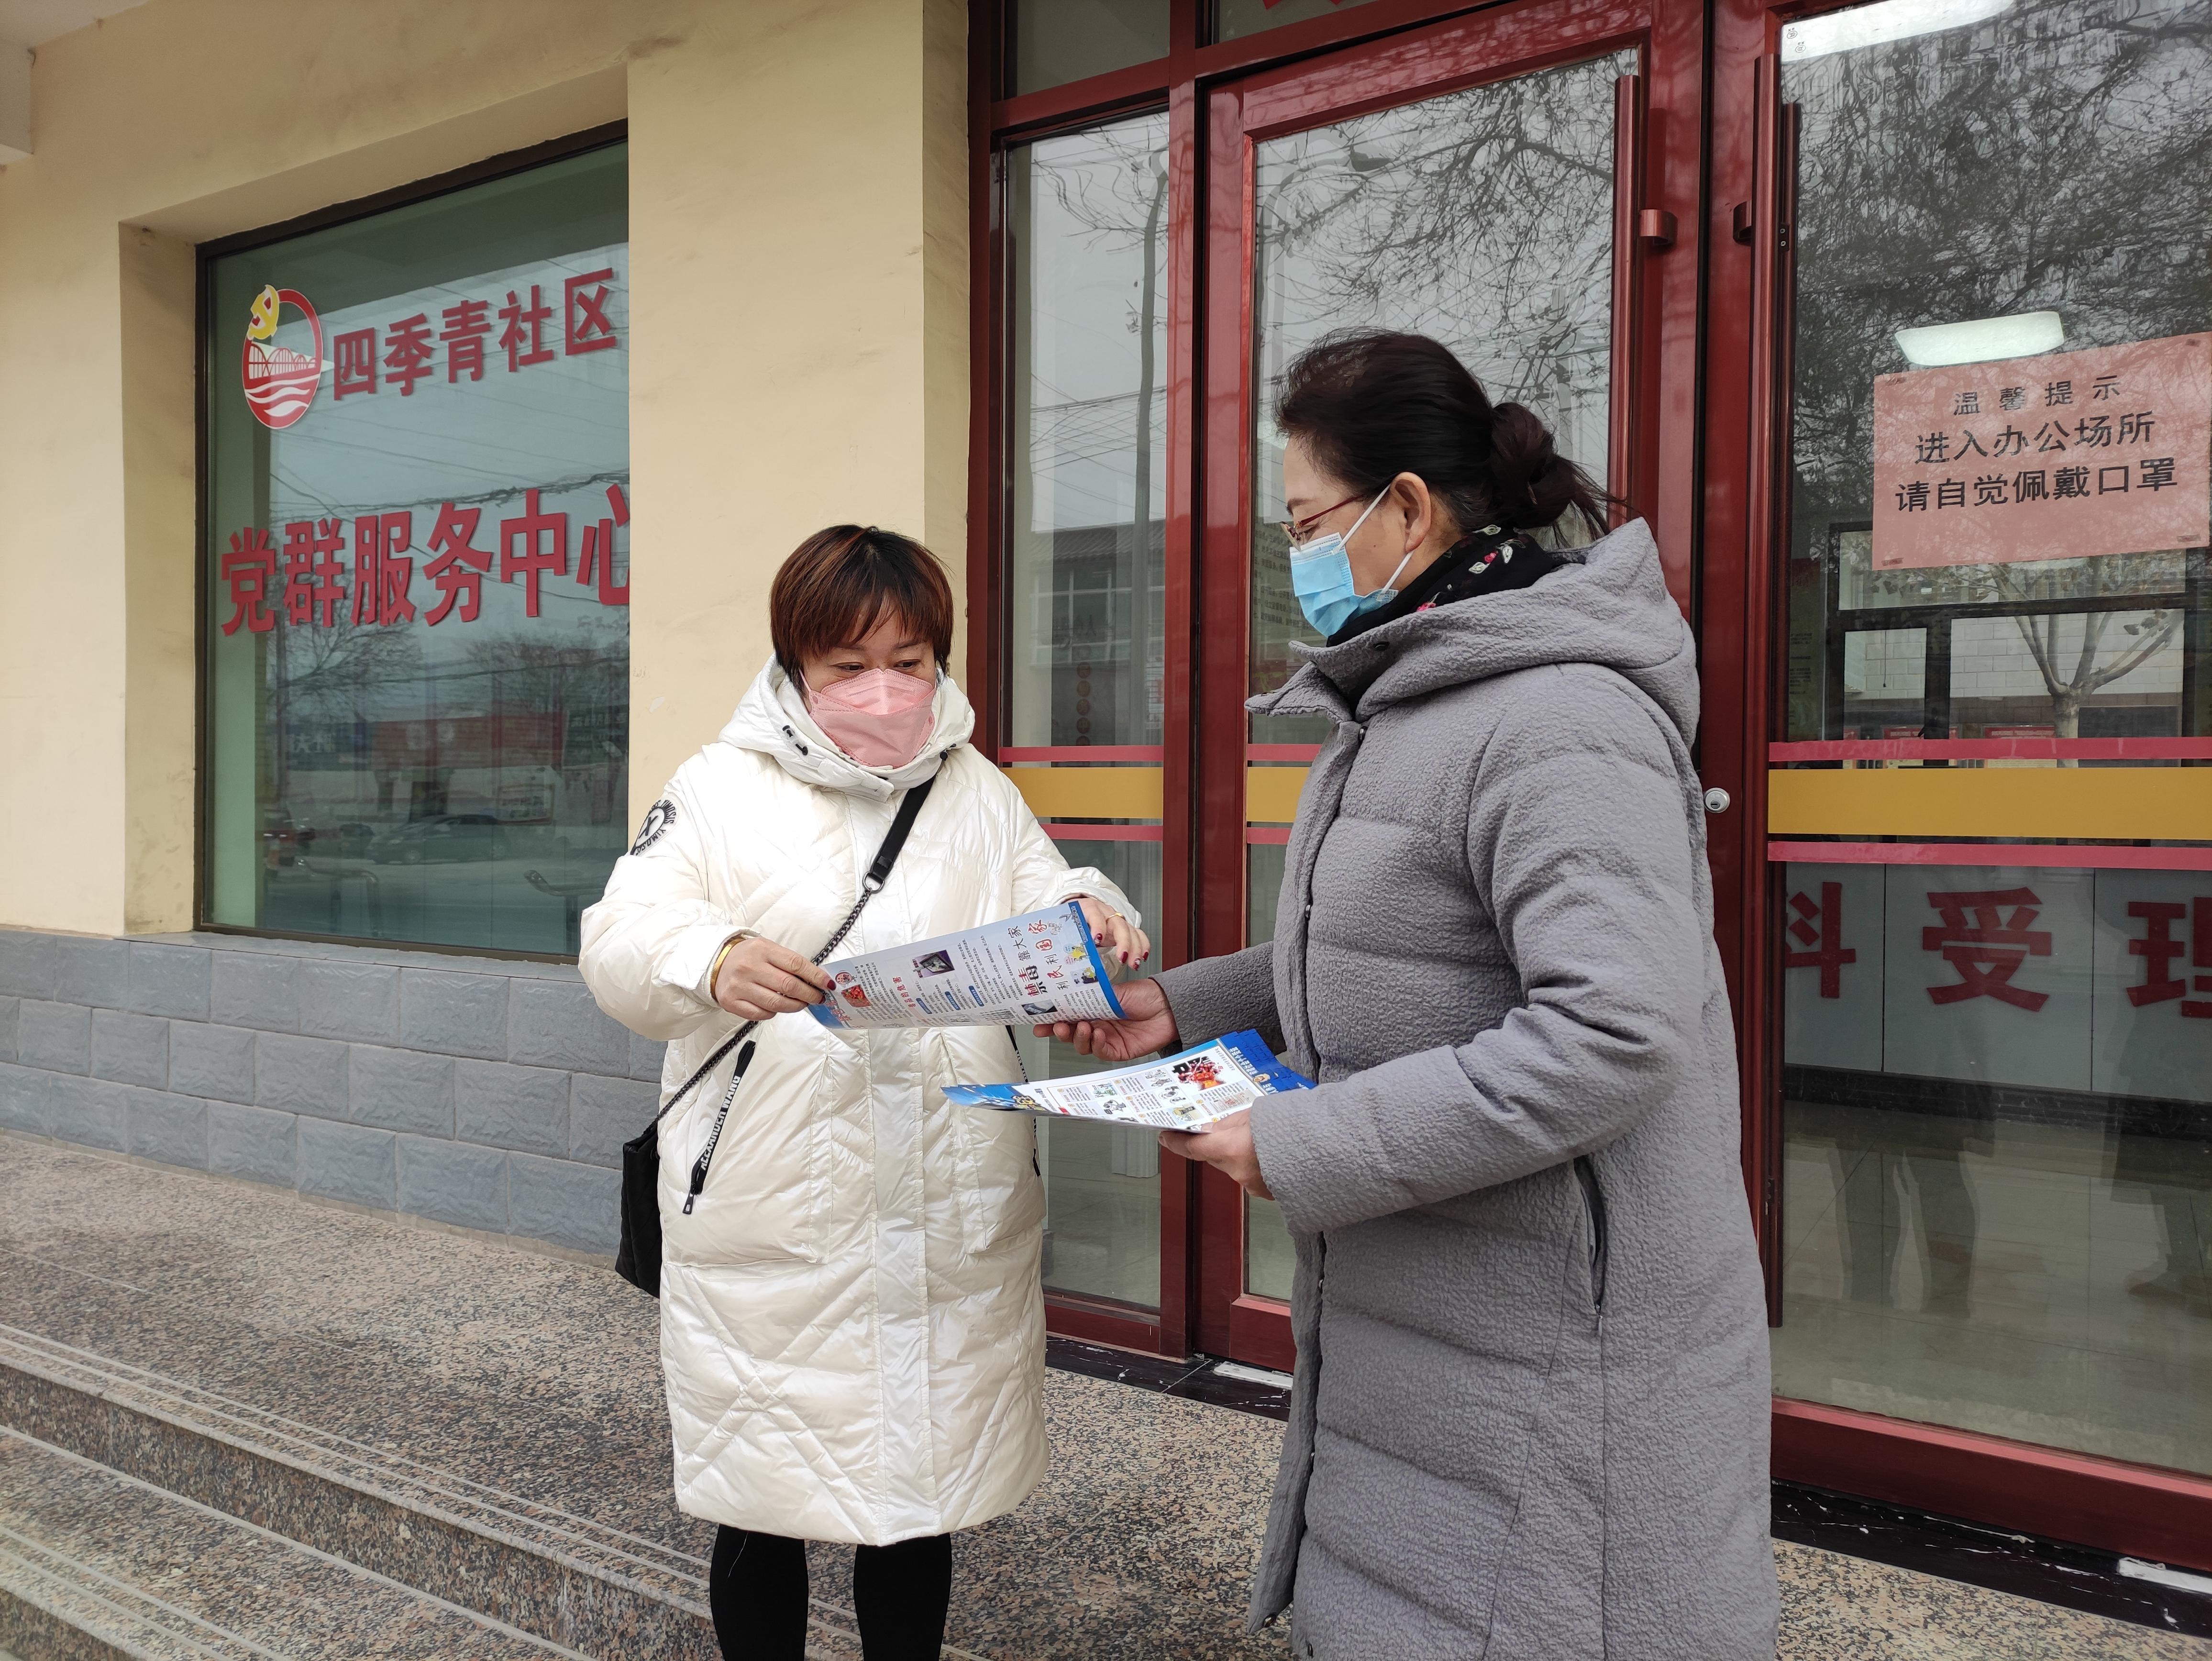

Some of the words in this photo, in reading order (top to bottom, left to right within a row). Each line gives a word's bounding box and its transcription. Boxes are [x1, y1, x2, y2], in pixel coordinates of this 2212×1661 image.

[333, 267, 618, 401] 四季青社区
[1953, 375, 2121, 416] 温馨提示
[1914, 410, 2155, 464] 进入办公场所
[1895, 457, 2178, 512] 请自觉佩戴口罩
[221, 484, 629, 636] 党群服务中心
[721, 1075, 741, 1108] WANG
